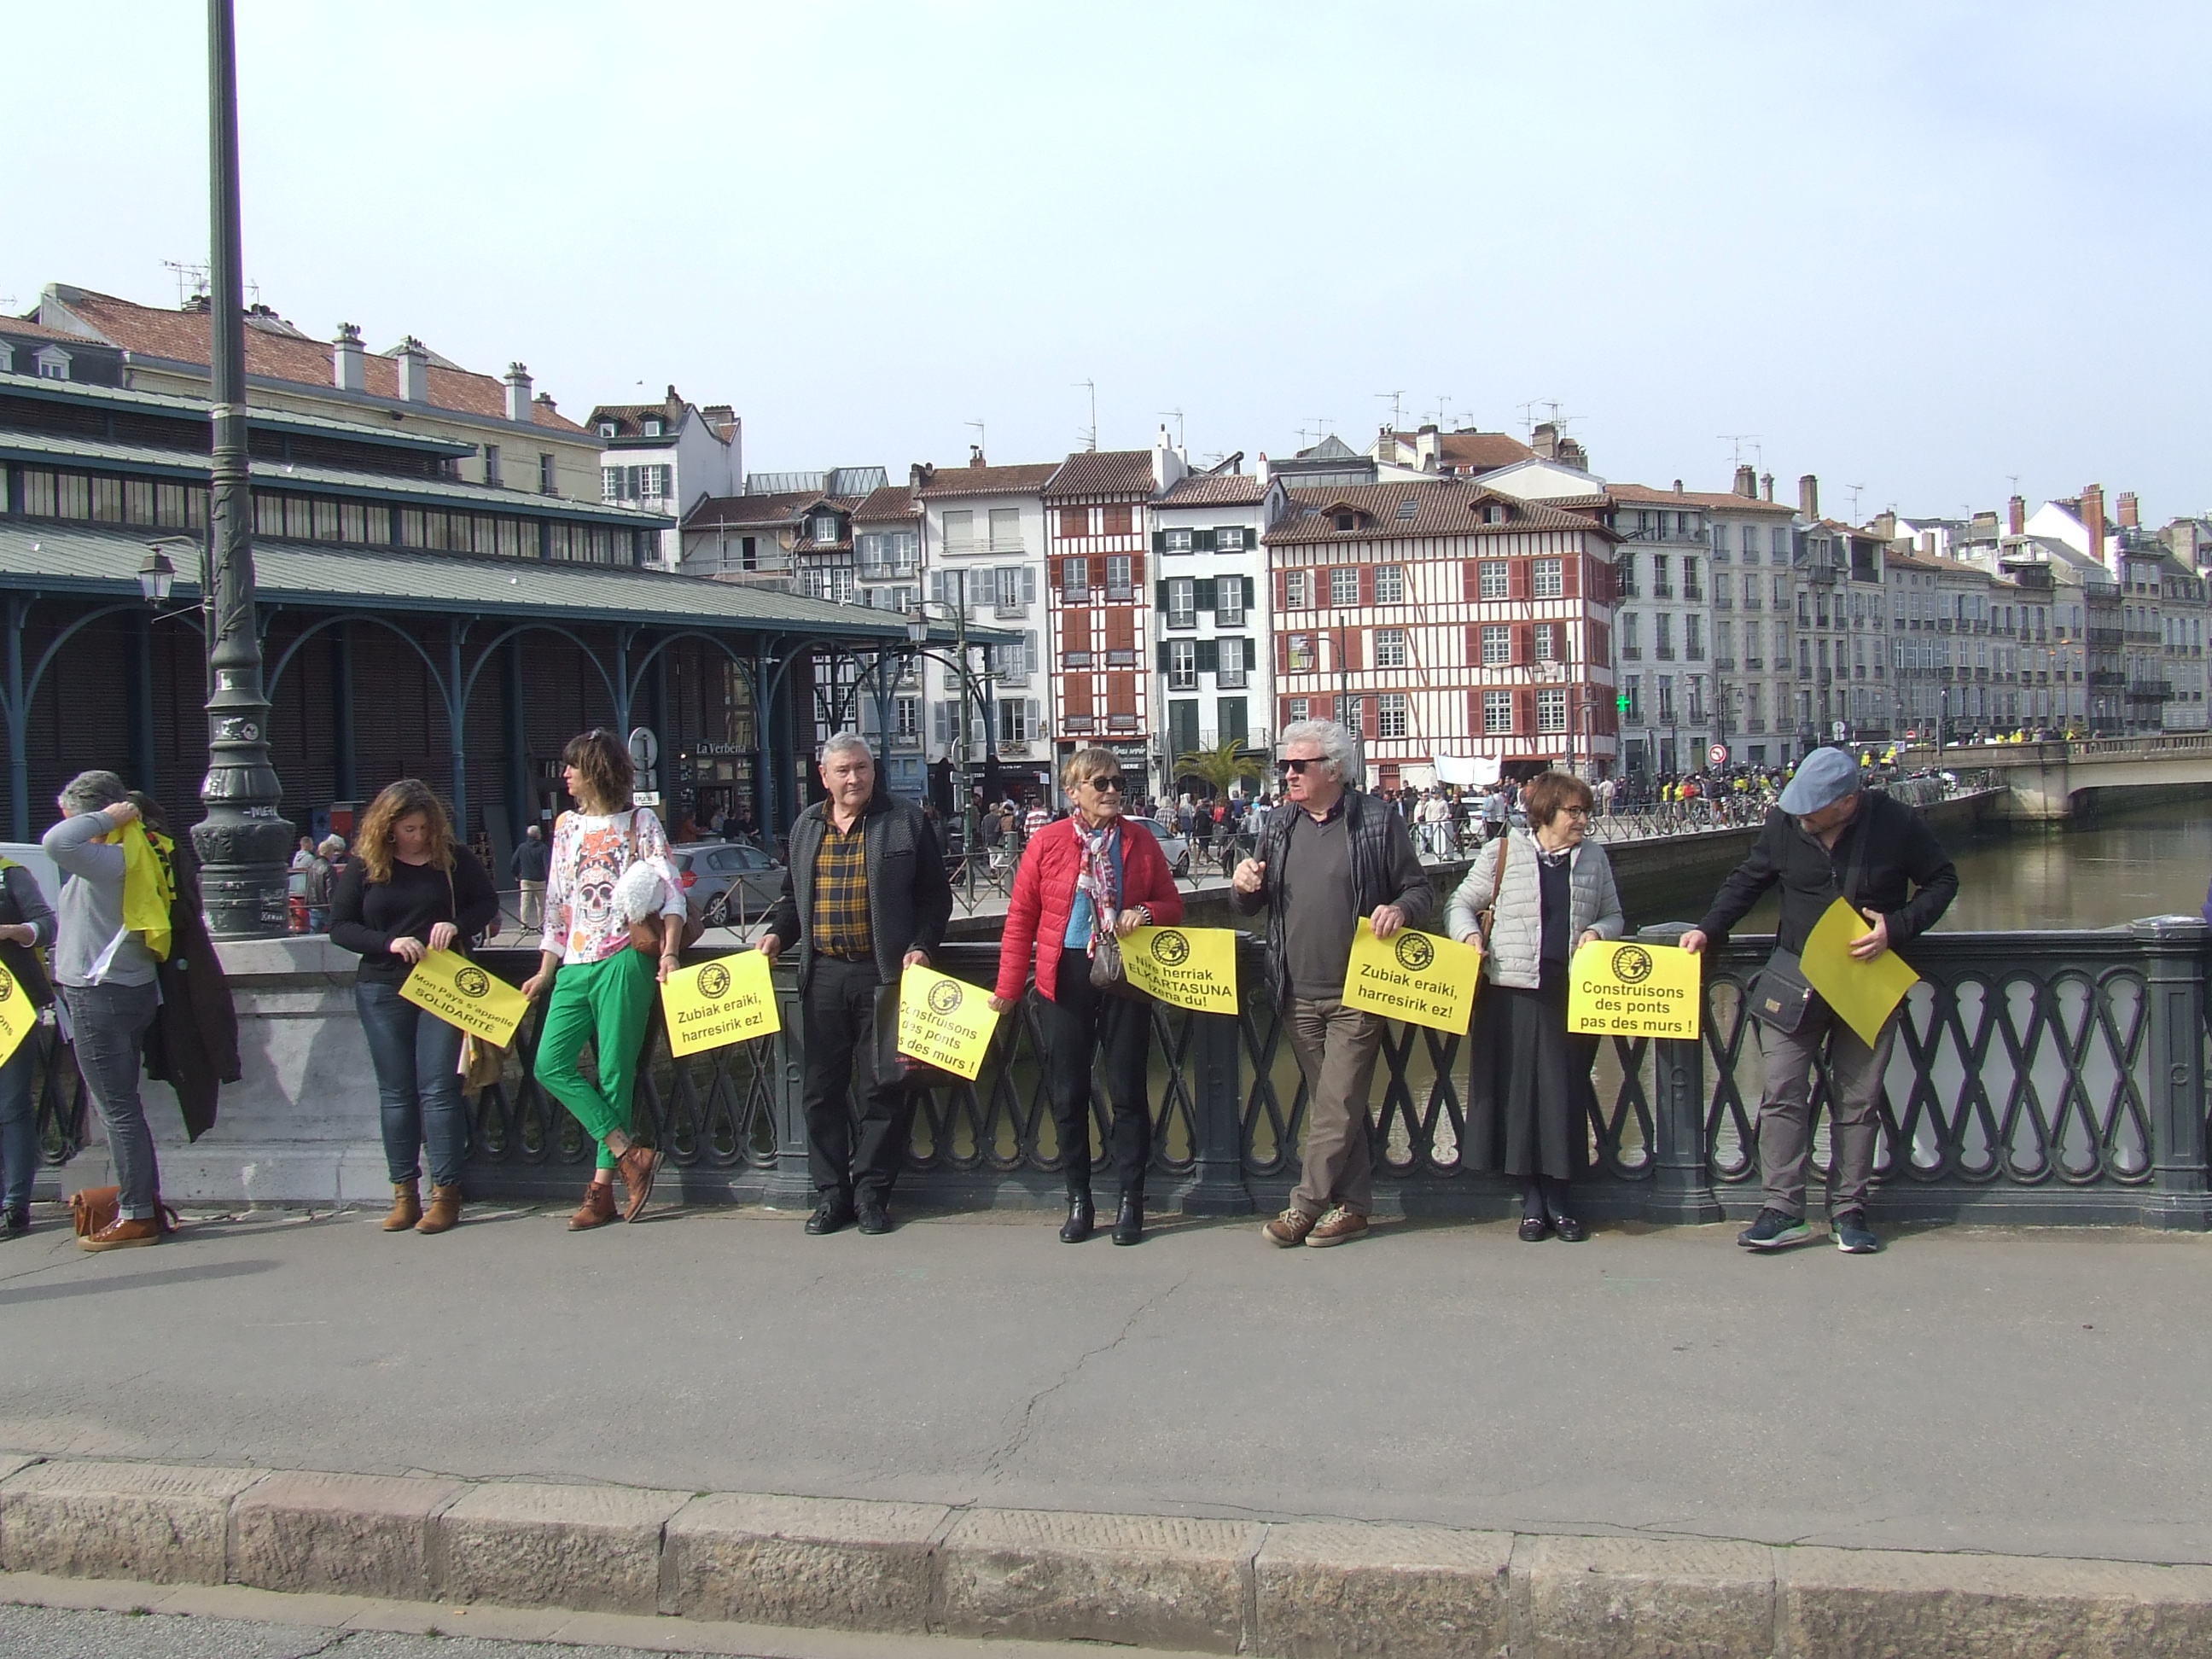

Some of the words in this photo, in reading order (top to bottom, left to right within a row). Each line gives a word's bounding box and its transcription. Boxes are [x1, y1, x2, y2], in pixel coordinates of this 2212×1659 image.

[696, 743, 707, 754] La
[708, 742, 747, 754] Verbéna
[1128, 962, 1232, 998] ELKARTASUNA
[1135, 955, 1160, 972] Nire
[1163, 967, 1214, 981] herriak
[1360, 963, 1411, 987] Zubiak
[1414, 979, 1458, 1000] eraiki,
[413, 974, 437, 990] Mon
[438, 987, 464, 1005] Pays
[1149, 981, 1181, 1002] izena
[1185, 995, 1208, 1007] du!
[1358, 984, 1428, 1013] harresirik
[1431, 1005, 1453, 1019] ez!
[1582, 981, 1685, 998] Construisons
[415, 987, 496, 1034] SOLIDARITÉ
[678, 1004, 721, 1023] Zubiak
[724, 992, 762, 1011] eraiki,
[1595, 998, 1621, 1010] des
[1627, 1001, 1670, 1015] ponts
[682, 1018, 742, 1043] harresirik
[745, 1011, 764, 1027] ez!
[902, 1019, 923, 1034] des
[924, 1029, 961, 1050] ponts
[1580, 1016, 1606, 1029] pas
[1611, 1016, 1638, 1029] des
[1644, 1020, 1682, 1032] murs
[907, 1039, 930, 1055] des
[932, 1050, 966, 1069] murs
